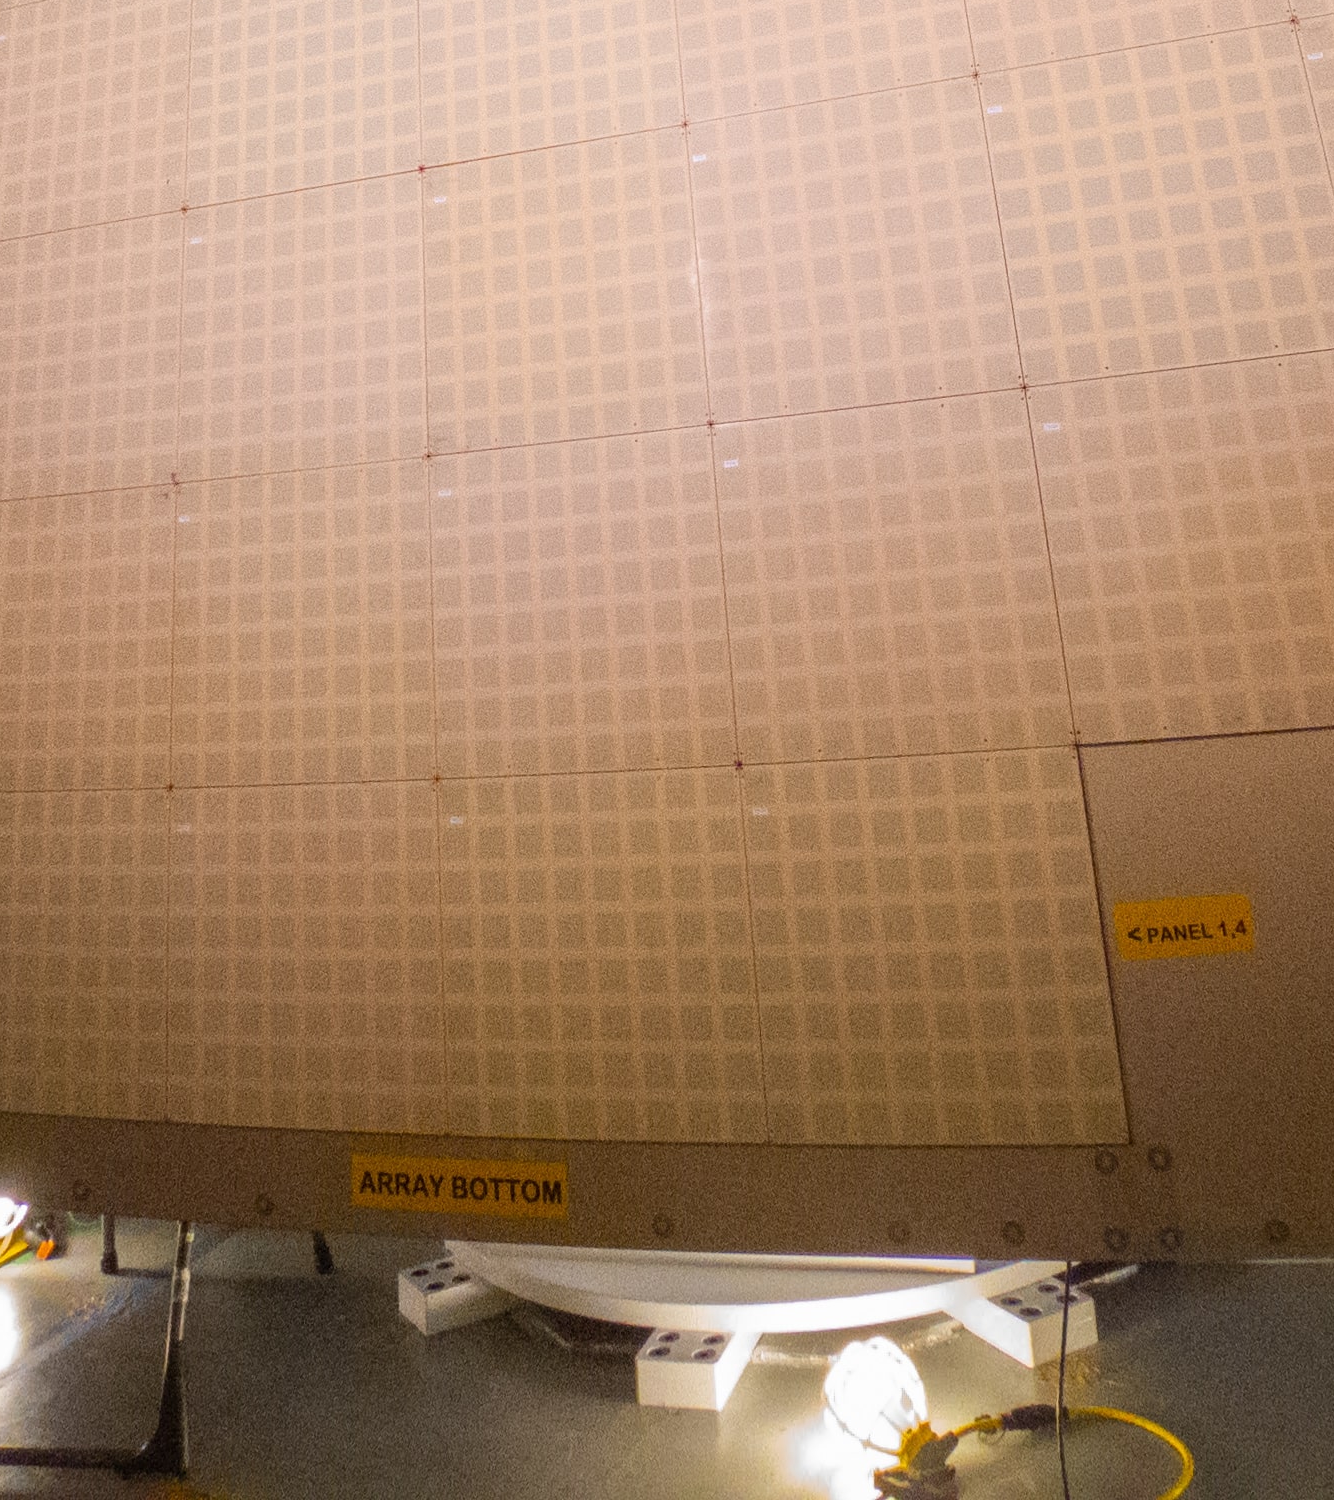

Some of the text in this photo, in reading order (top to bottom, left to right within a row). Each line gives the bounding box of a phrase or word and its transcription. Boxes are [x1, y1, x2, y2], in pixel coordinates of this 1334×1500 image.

[1146, 919, 1247, 944] PANEL 1,4
[359, 1170, 563, 1204] ARRAY BOTTOM
